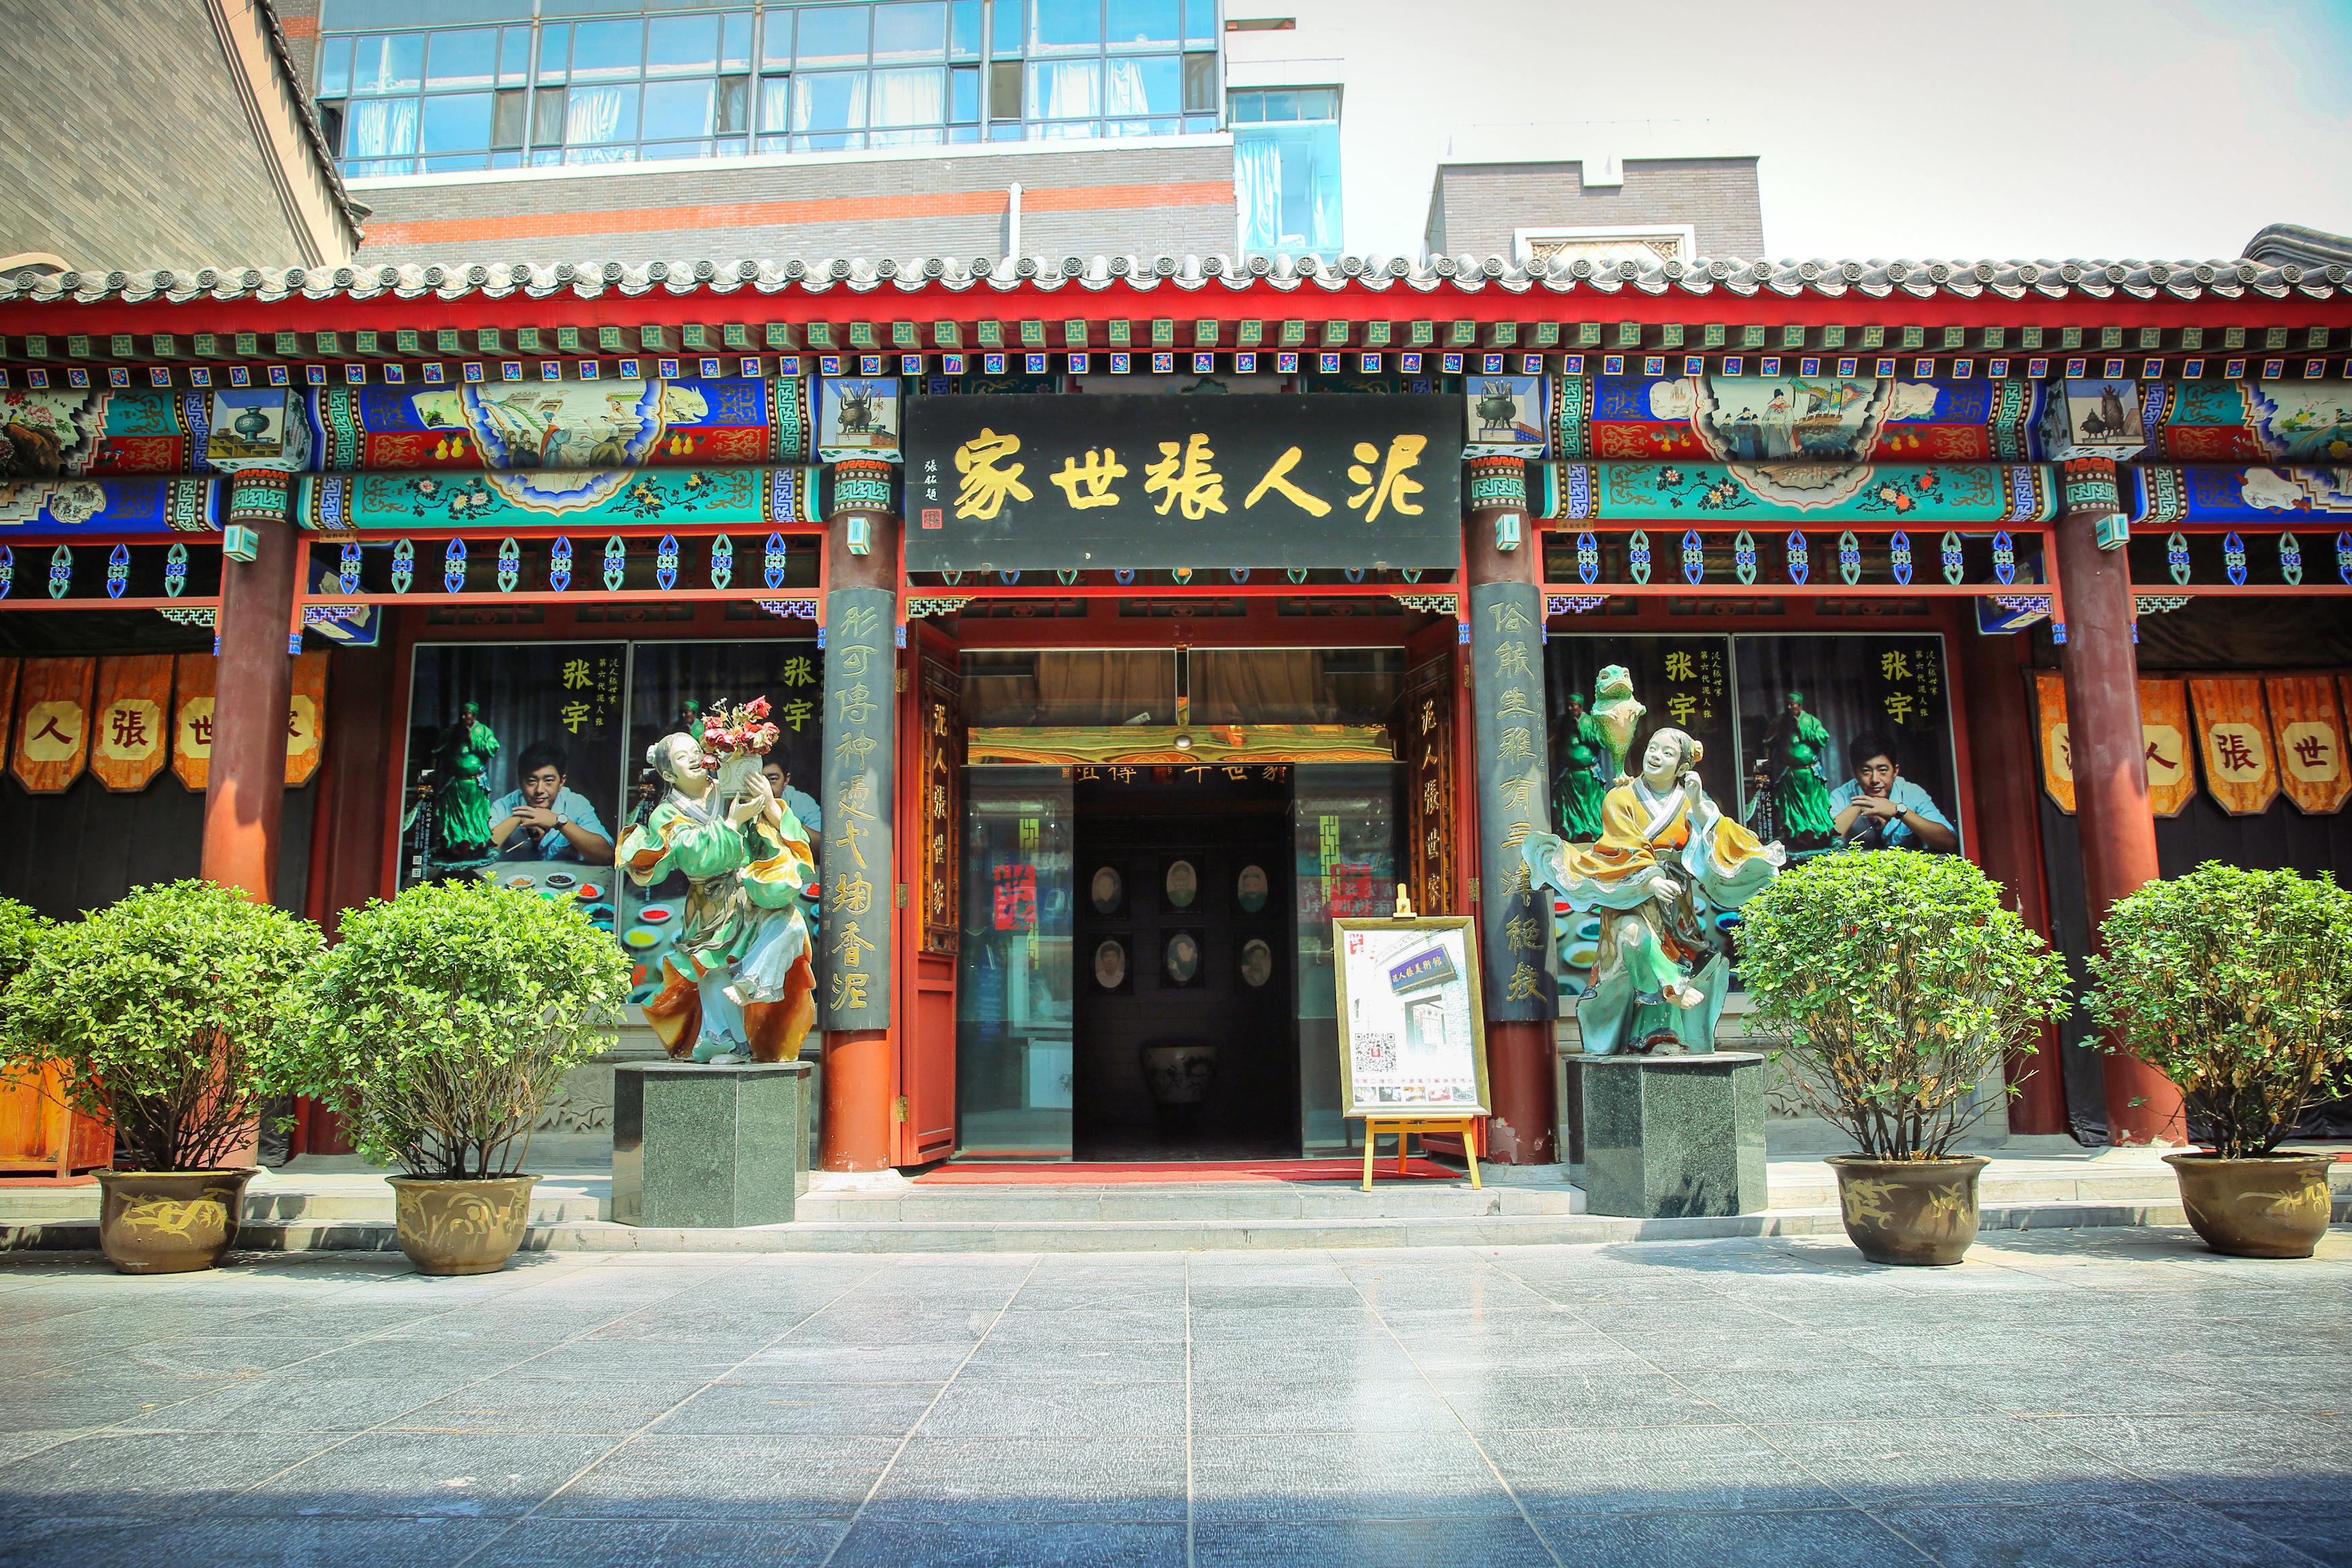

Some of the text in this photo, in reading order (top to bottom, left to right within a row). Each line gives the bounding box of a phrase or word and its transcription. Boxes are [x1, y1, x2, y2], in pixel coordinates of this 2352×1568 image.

[953, 427, 1428, 523] 泥人張世家
[560, 658, 594, 734] 张宇
[782, 656, 816, 732] 张宇
[1665, 651, 1698, 726] 张宇
[1881, 650, 1913, 724] 张宇
[32, 716, 73, 744] 人
[112, 709, 149, 748] 張
[2217, 734, 2259, 772] 張
[2294, 735, 2329, 767] 世
